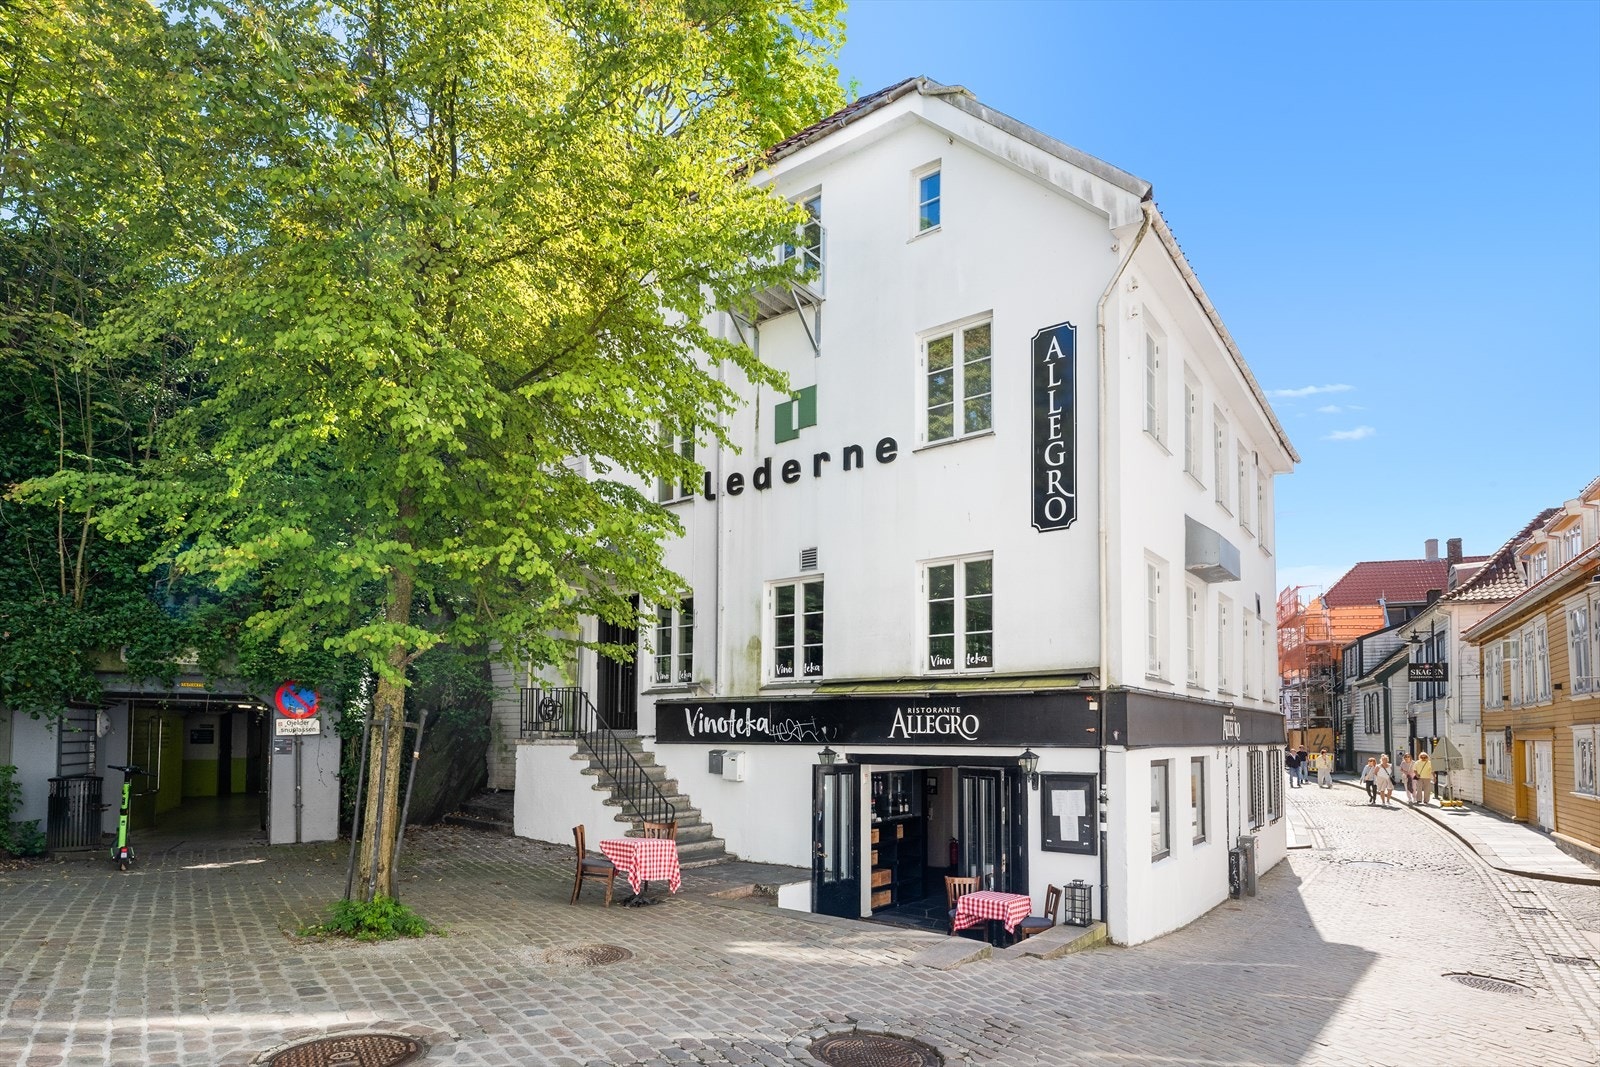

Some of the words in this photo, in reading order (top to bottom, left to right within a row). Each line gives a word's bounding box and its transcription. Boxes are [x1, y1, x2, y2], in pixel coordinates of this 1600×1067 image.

[1043, 335, 1074, 521] ALLEGRO
[704, 437, 898, 501] lederne
[929, 654, 952, 667] Vino
[966, 652, 988, 666] teka
[655, 671, 670, 681] Vino
[678, 669, 692, 680] teka
[775, 664, 793, 675] Vino
[803, 662, 821, 673] teka
[907, 706, 961, 714] RISTORANTE
[286, 719, 310, 727] Gjelder
[684, 706, 770, 738] Vinoteka
[887, 707, 980, 741] ALLEGRO
[281, 726, 317, 734] snuplassen
